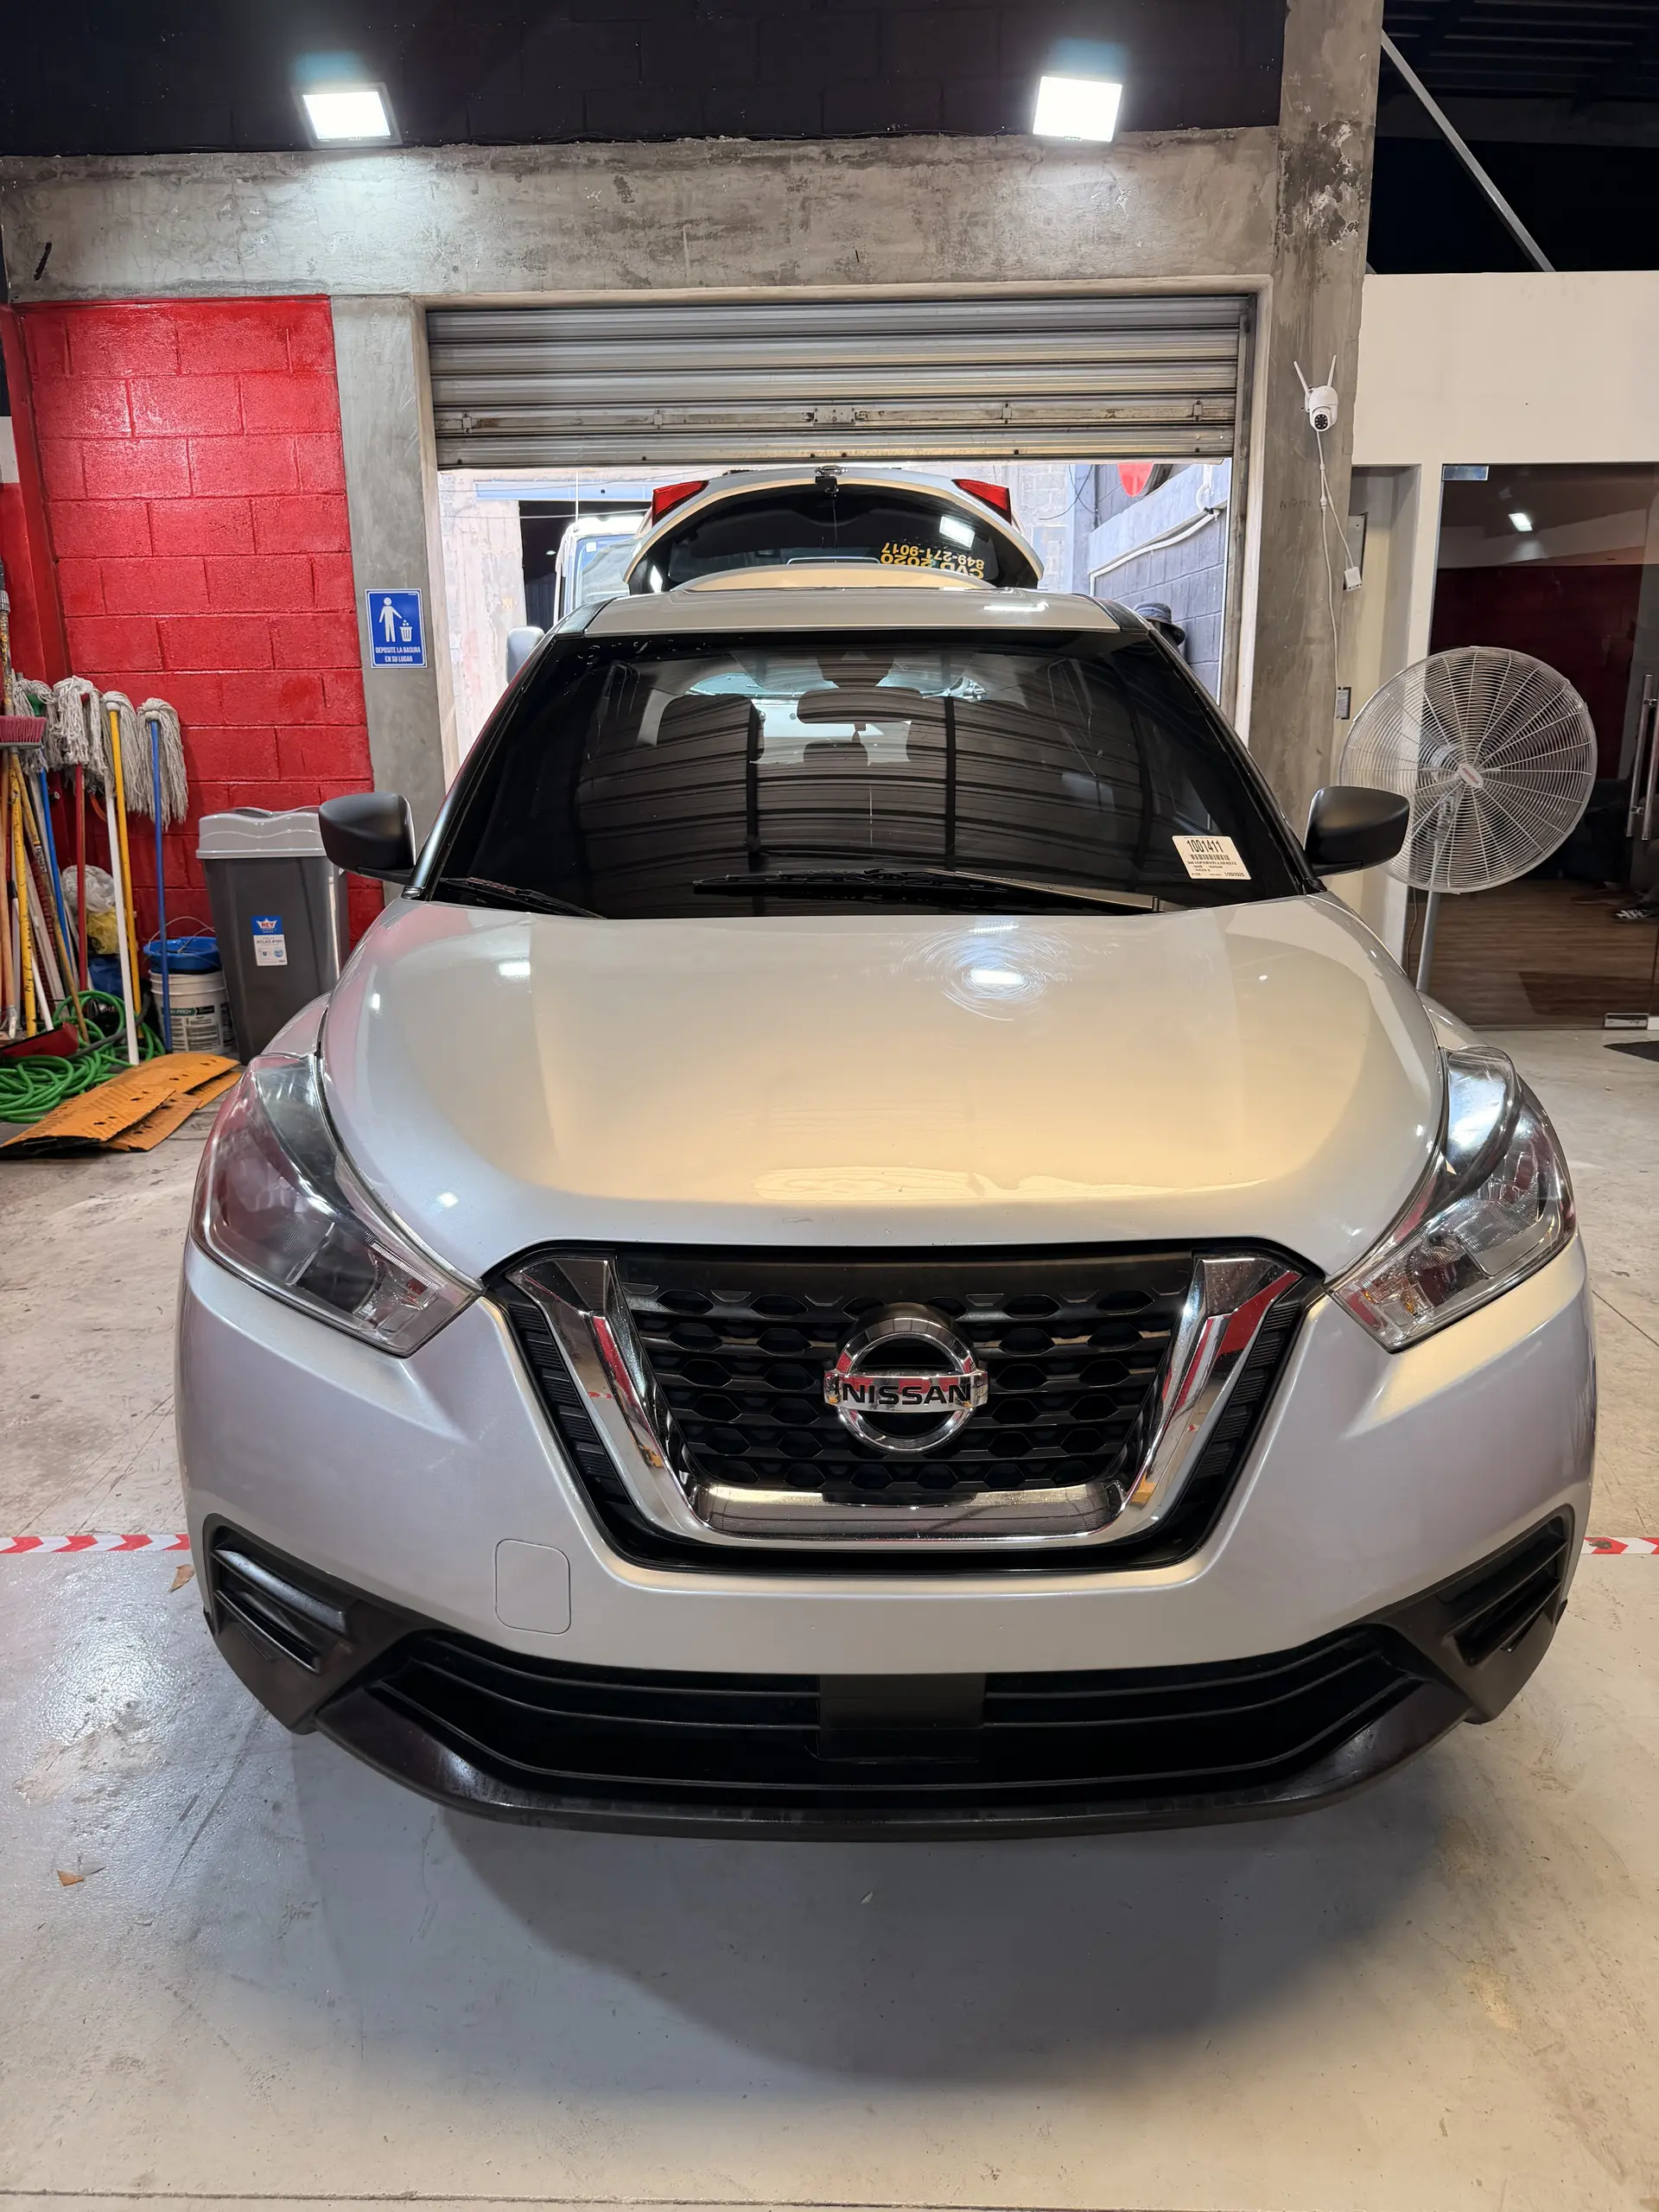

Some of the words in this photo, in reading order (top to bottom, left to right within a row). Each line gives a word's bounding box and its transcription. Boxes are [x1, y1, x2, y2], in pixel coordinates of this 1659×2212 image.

[880, 554, 932, 568] 2020
[881, 542, 985, 570] 849-271-9017
[1186, 839, 1224, 853] 1001411
[842, 1382, 971, 1406] NISSAN
